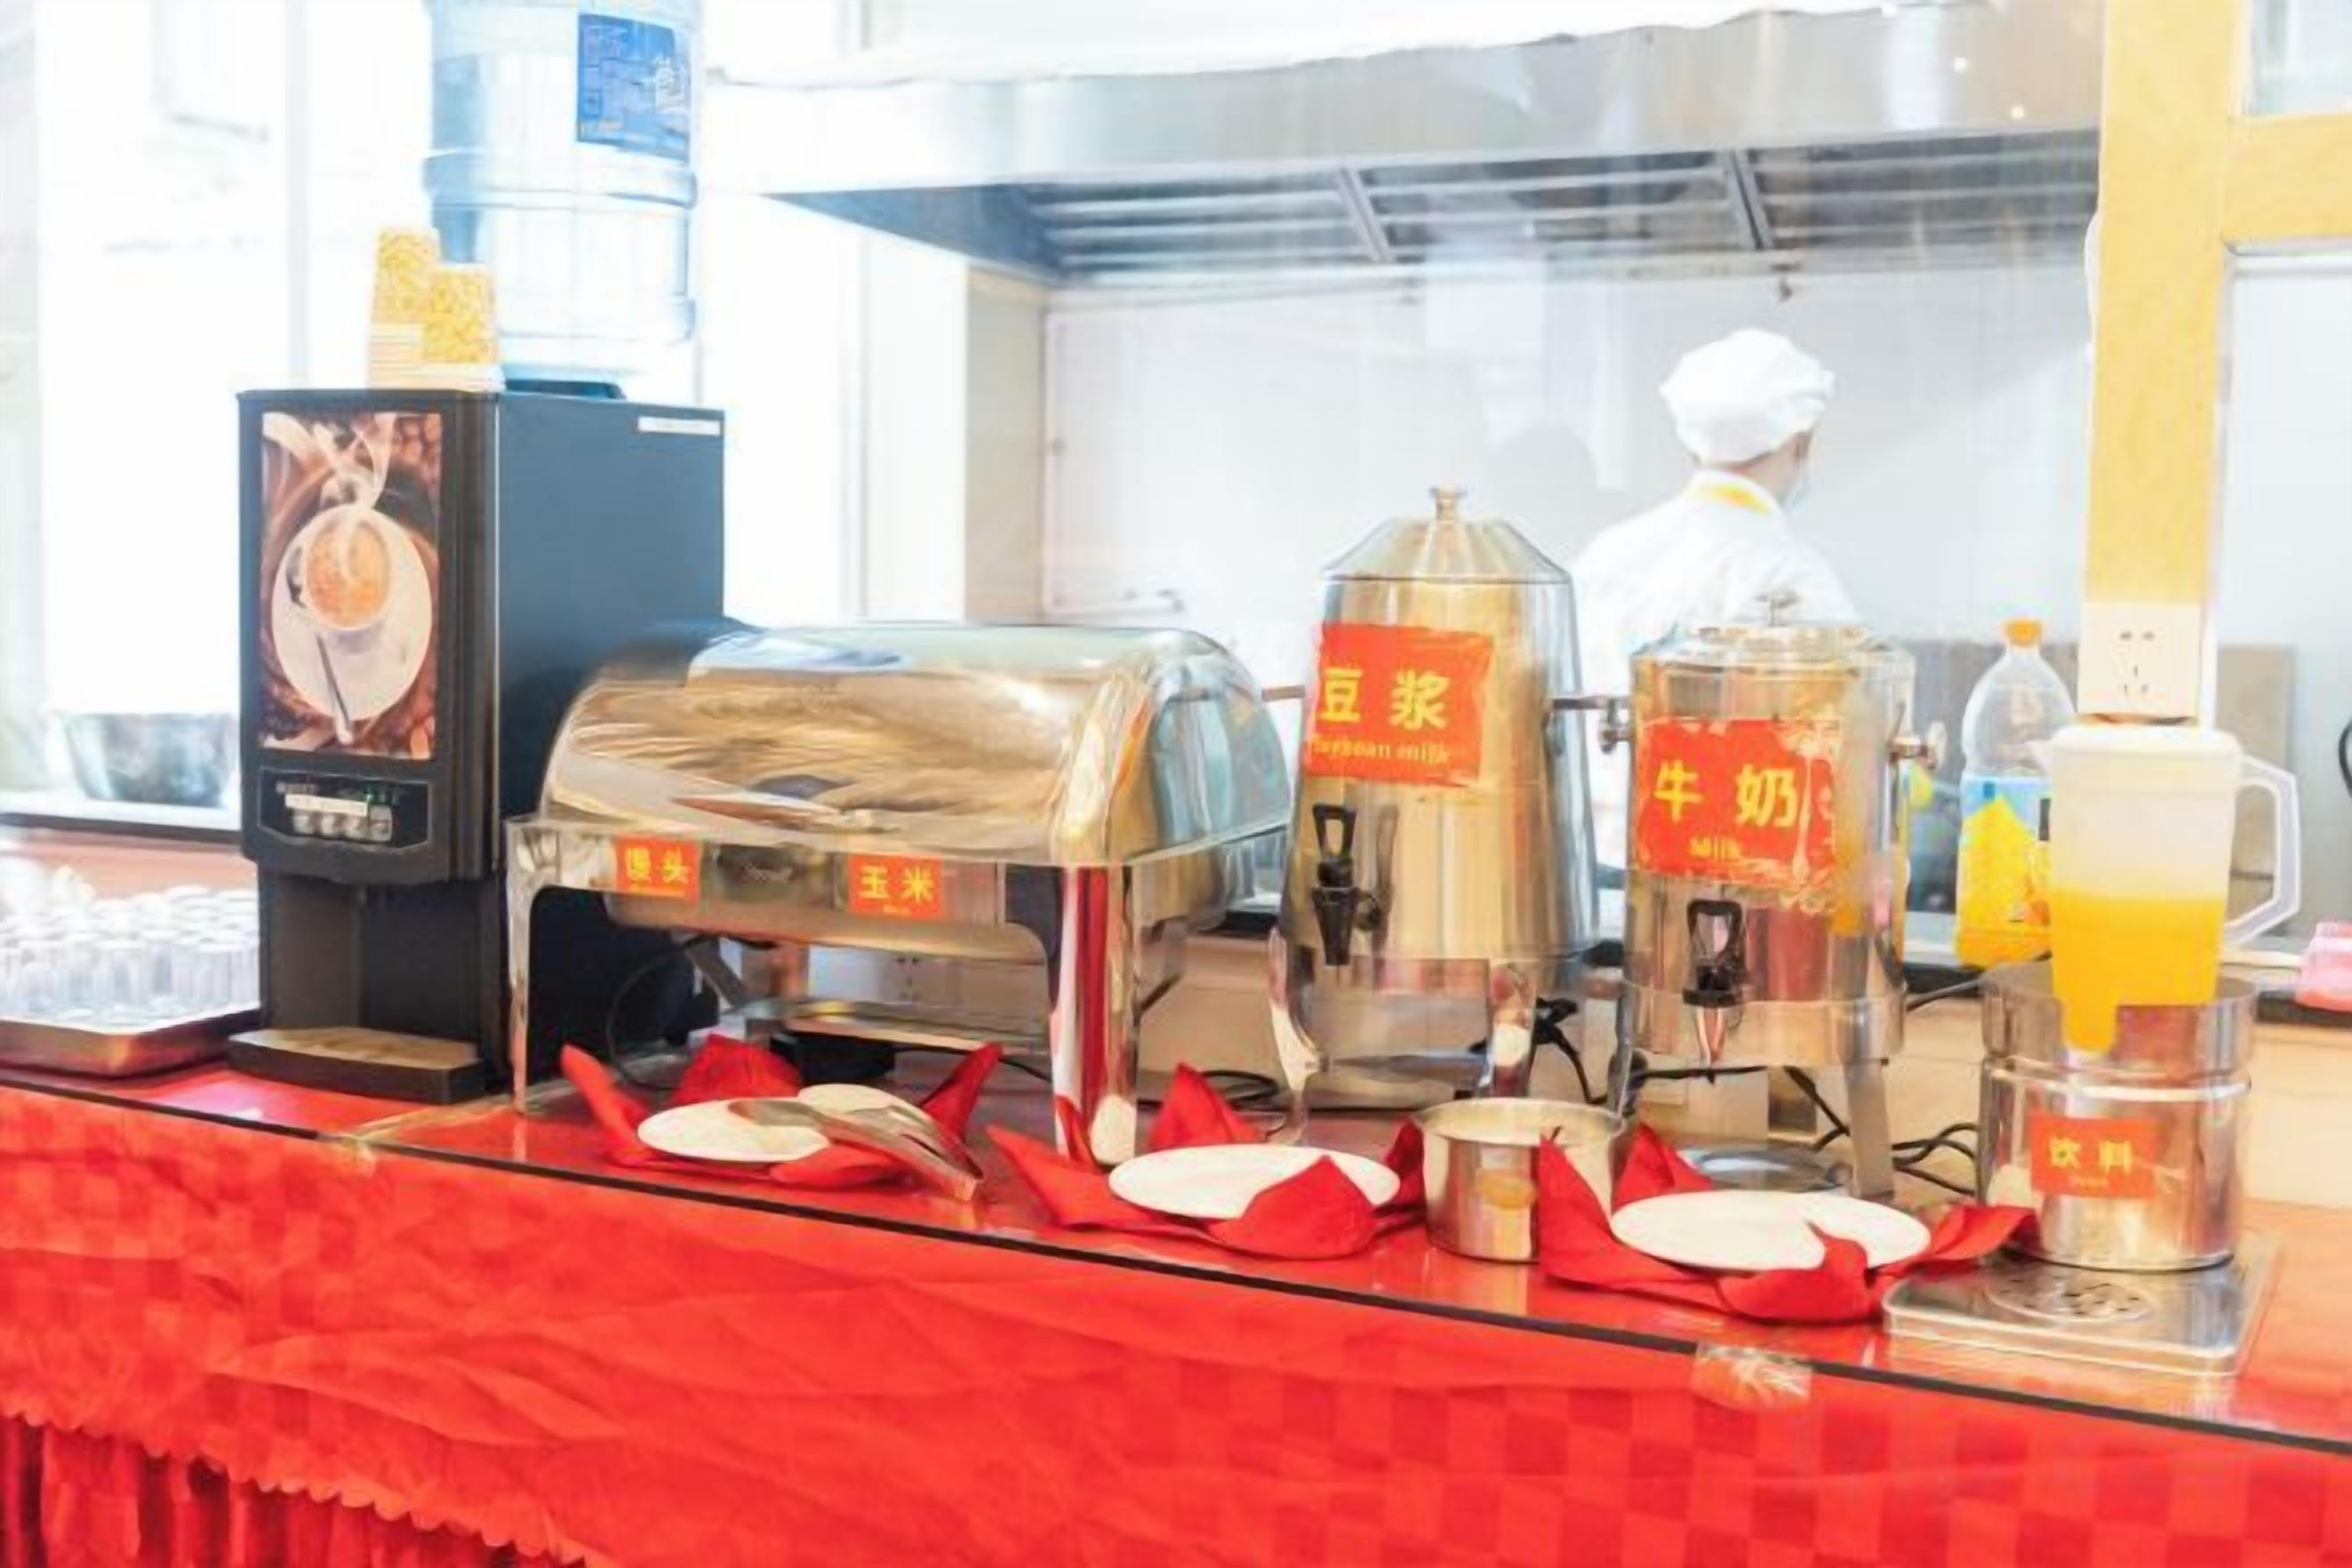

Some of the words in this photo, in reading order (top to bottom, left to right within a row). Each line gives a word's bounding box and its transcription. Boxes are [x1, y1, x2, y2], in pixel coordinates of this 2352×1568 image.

[1318, 666, 1450, 730] 豆浆
[1654, 759, 1799, 828] 牛奶
[859, 865, 935, 902] 玉米
[2049, 1137, 2132, 1174] 饮料
